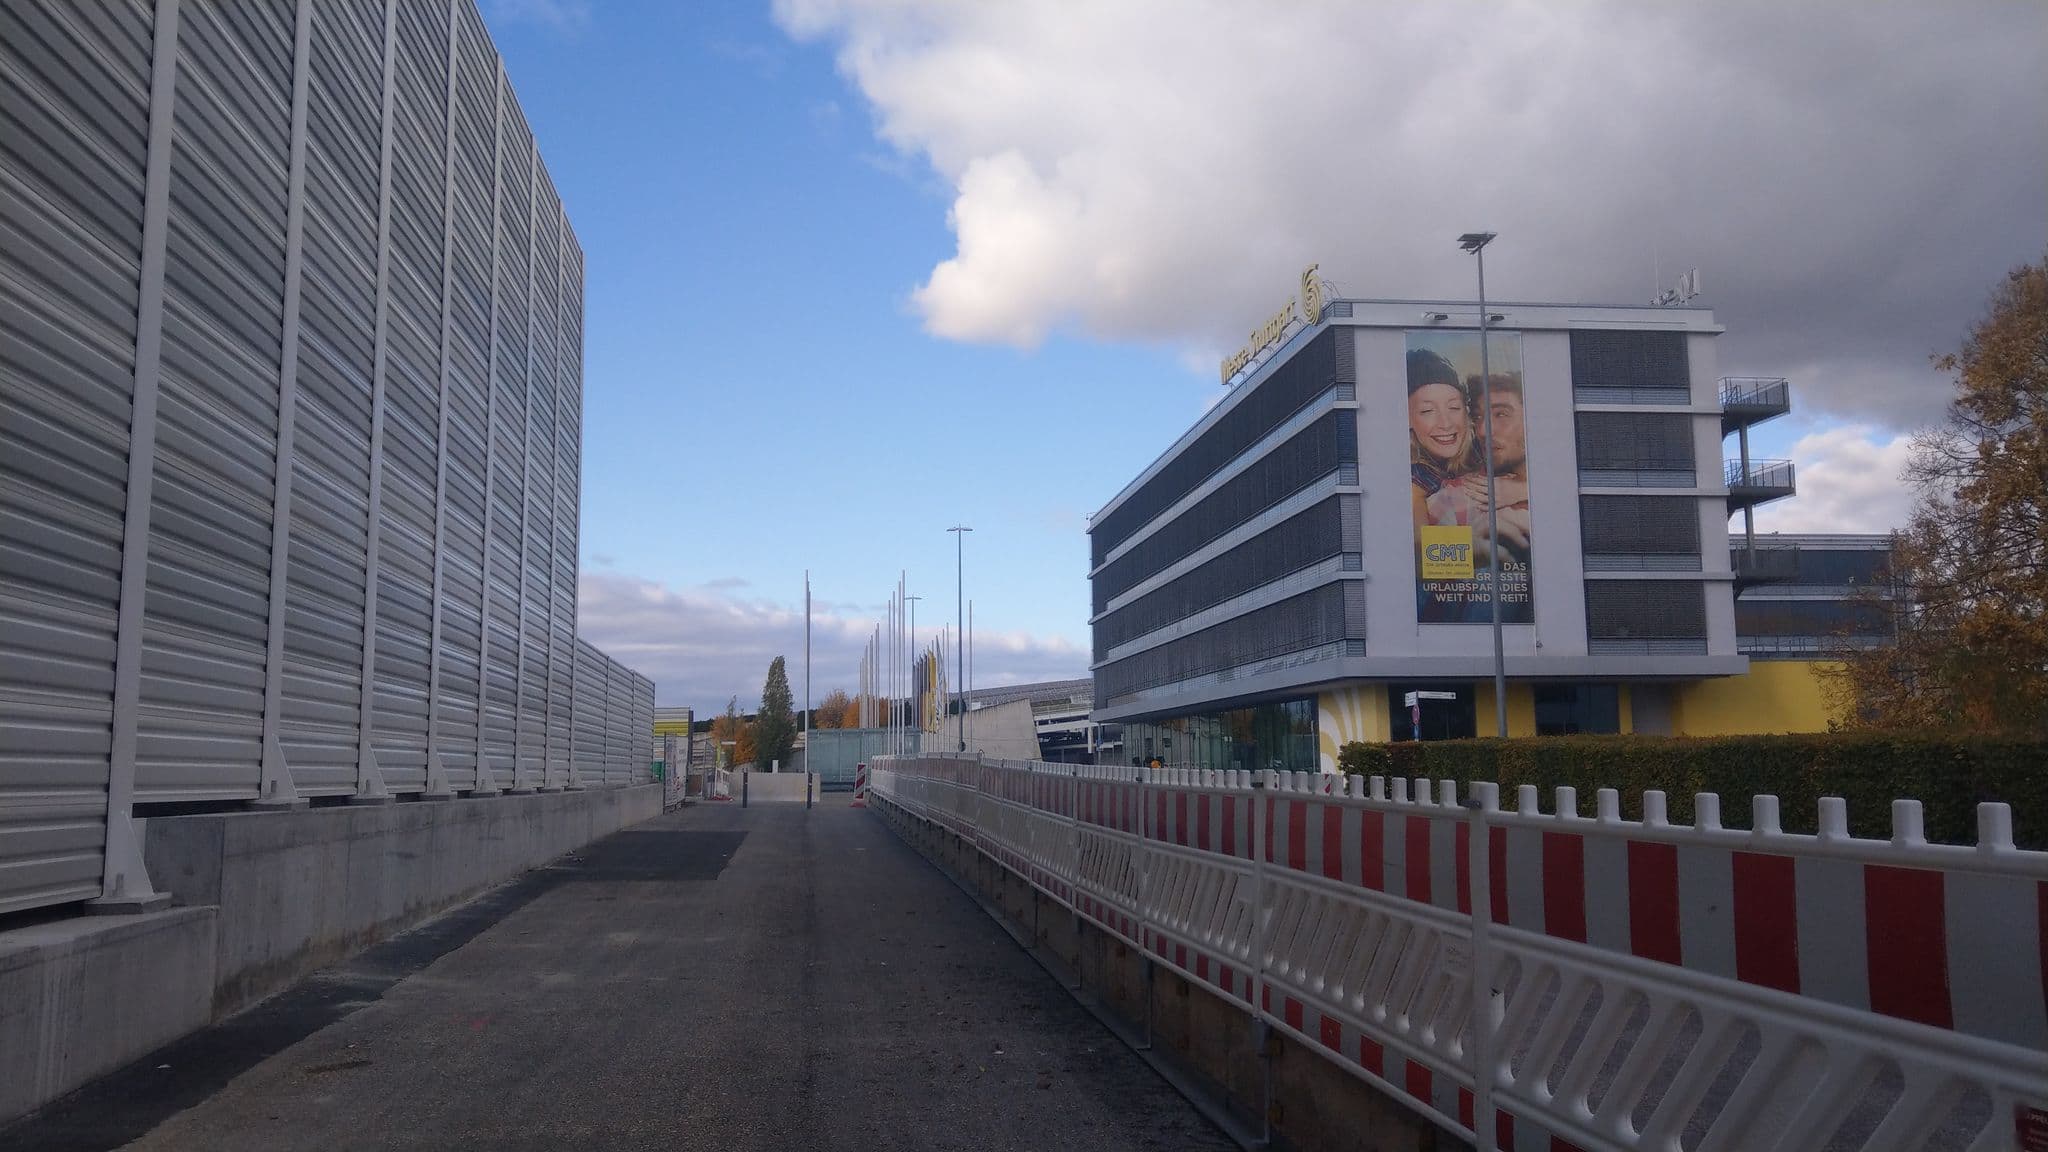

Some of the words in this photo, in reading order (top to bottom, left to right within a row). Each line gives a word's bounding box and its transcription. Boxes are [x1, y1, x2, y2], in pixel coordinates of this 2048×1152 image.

[1426, 543, 1470, 562] CMT
[1503, 562, 1527, 571] DAS
[1476, 573, 1527, 581] GRSSTE
[1423, 583, 1528, 592] URLAUBSPARDIES
[1435, 593, 1464, 602] WEIT
[1467, 593, 1491, 602] UND
[1498, 593, 1528, 602] REIT!
